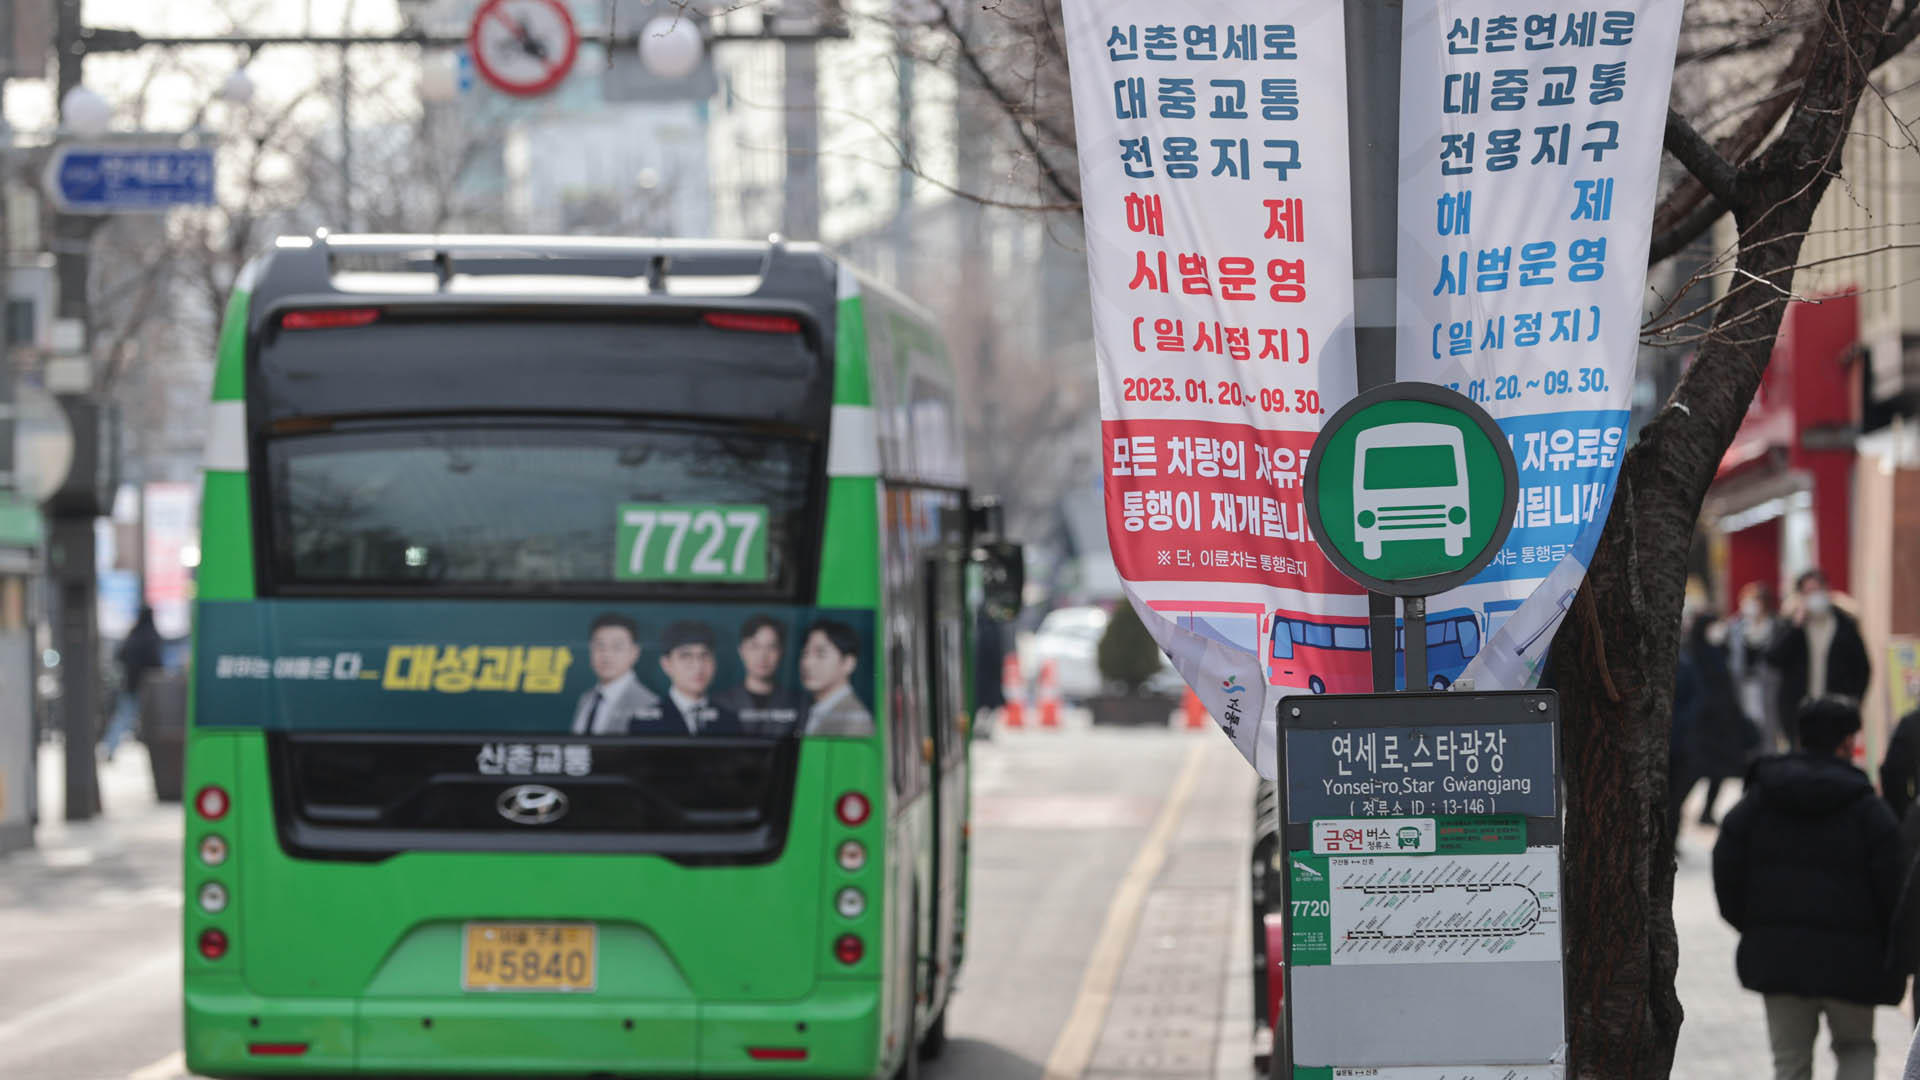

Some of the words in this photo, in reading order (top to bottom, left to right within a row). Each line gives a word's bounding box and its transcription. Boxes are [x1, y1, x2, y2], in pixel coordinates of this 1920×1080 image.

[1107, 24, 1297, 61] 신촌연세로
[1447, 11, 1635, 55] 신촌연세로
[1114, 77, 1299, 120] 대중교통
[1443, 61, 1627, 114] 대중교통
[1119, 136, 1301, 181] 전용지구
[1439, 120, 1619, 176] 전용지구
[1128, 250, 1306, 303] 시범운영
[1433, 237, 1607, 296] 시범운영
[1133, 316, 1309, 364] (일시정지)
[1432, 306, 1600, 359] (일시정지)
[1112, 435, 1157, 477] 모든
[1166, 436, 1246, 480] 차량의
[1522, 427, 1623, 472] 자유로운
[1123, 490, 1201, 532] 통행이
[1210, 492, 1315, 543] 재개됩니
[623, 510, 761, 575] 7727
[1200, 549, 1257, 569] 이륜차는
[1260, 554, 1307, 577] 통행금지
[382, 644, 573, 693] 대성과탐
[477, 743, 592, 776] 신촌교통
[1411, 801, 1425, 815] ID
[1443, 799, 1484, 814] 13-146
[1443, 776, 1531, 795] Gwangjang
[1323, 828, 1363, 851] 금연
[1366, 827, 1391, 840] 버스
[1367, 841, 1392, 851] 정류소
[1291, 900, 1330, 917] 7720
[499, 949, 586, 982] 5840
